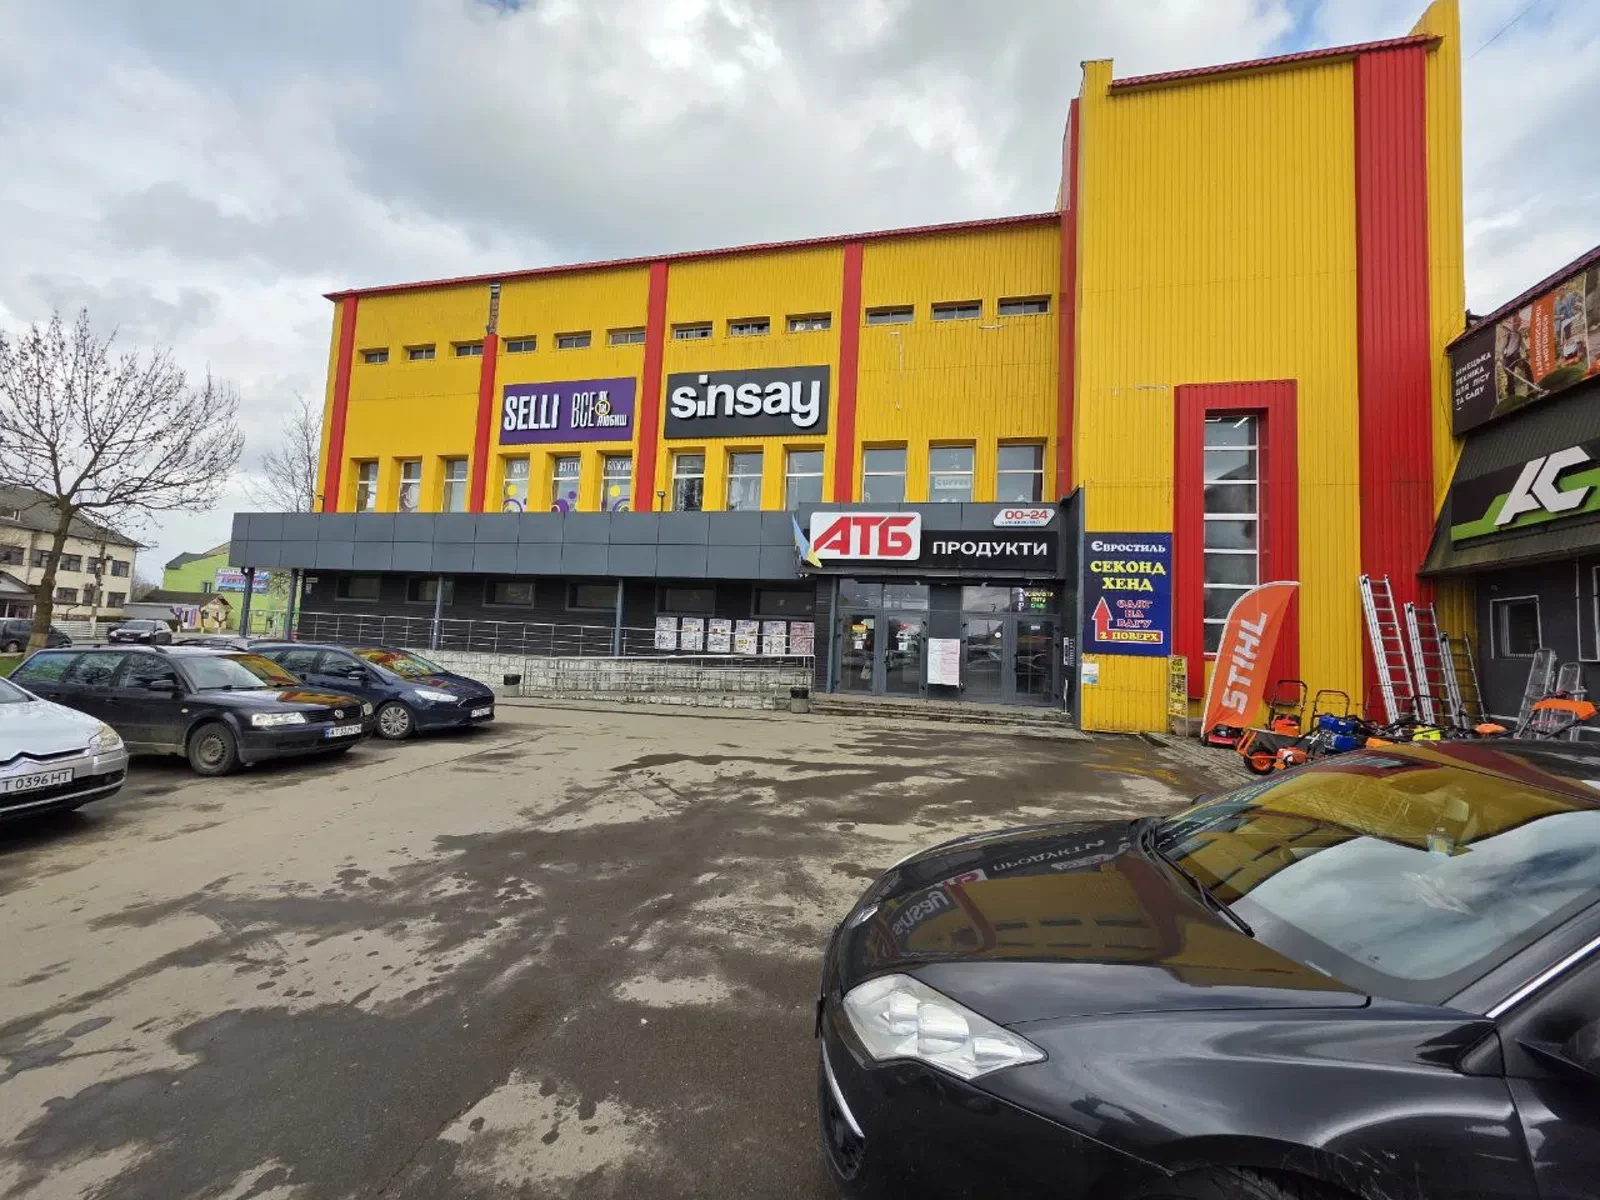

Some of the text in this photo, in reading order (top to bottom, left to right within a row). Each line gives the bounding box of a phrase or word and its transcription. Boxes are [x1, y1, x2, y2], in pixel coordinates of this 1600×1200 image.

[1455, 351, 1492, 377] НІМЕЦЬКА
[1455, 366, 1485, 386] ТЕХНІКА
[1455, 372, 1491, 397] ДЛЯ ЛІСУ
[670, 374, 821, 427] sinsay
[1455, 386, 1486, 406] ТА САДУ
[503, 393, 560, 431] SELLI
[571, 391, 597, 429] ВСЕ
[1004, 509, 1049, 520] 00-24
[813, 516, 917, 557] АТБ
[932, 541, 1048, 558] ПРОДУКТИ
[1090, 561, 1167, 576] СЕКОНД
[1102, 577, 1154, 592] ХЕНД
[1116, 599, 1153, 609] ОДЯГ
[1124, 610, 1144, 618] НА
[1116, 619, 1152, 629] ВАГУ
[1100, 632, 1160, 641] 2 ПОВЕРХ
[1221, 612, 1269, 715] STIHL
[15, 776, 48, 790] 0396
[51, 771, 71, 784] HT
